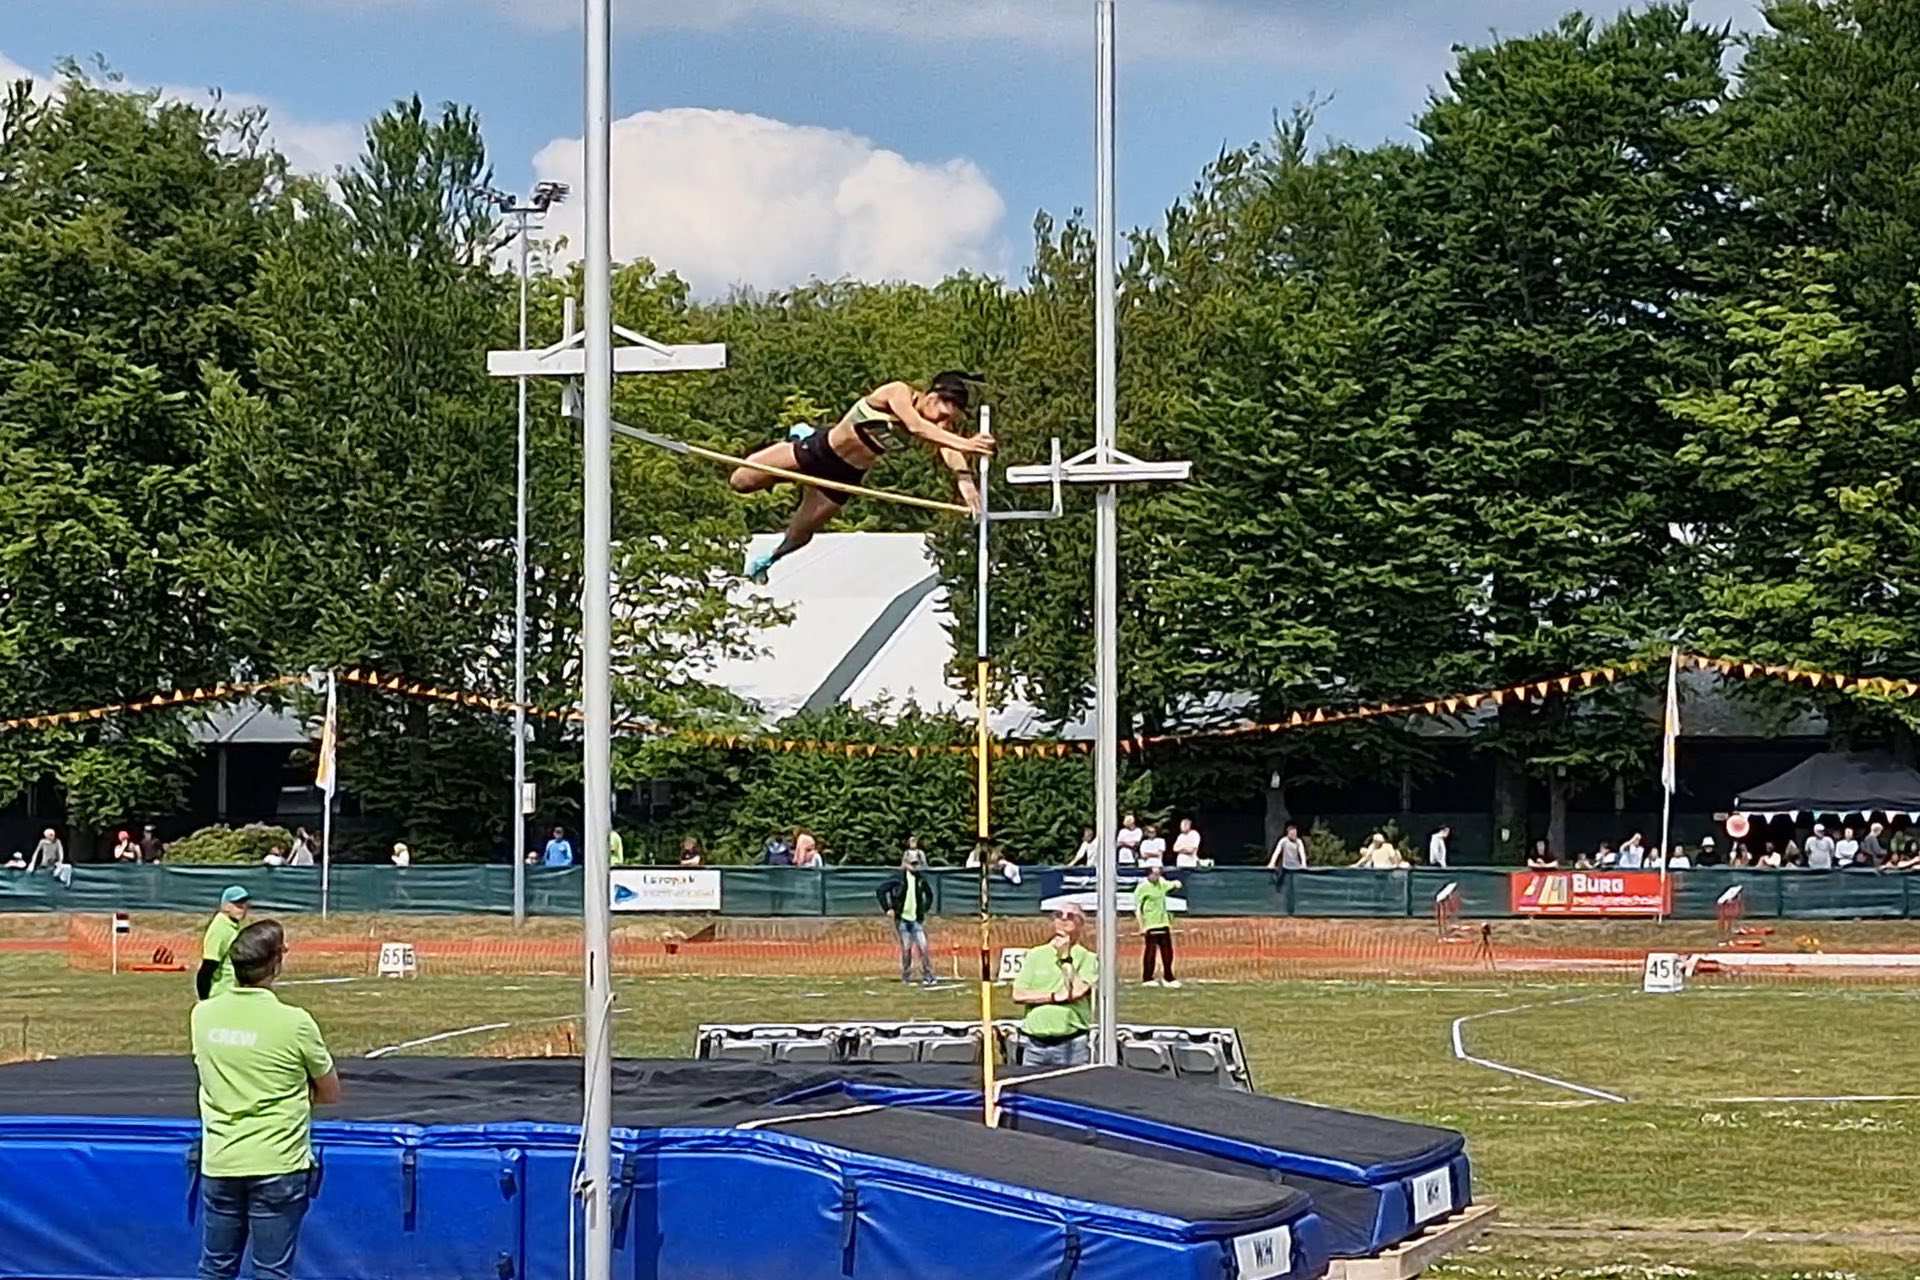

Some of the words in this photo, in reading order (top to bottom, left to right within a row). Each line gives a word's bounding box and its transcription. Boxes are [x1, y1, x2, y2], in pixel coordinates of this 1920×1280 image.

[382, 948, 400, 965] 65
[1003, 954, 1022, 973] 55
[1649, 959, 1670, 978] 45
[208, 1028, 257, 1047] CREW
